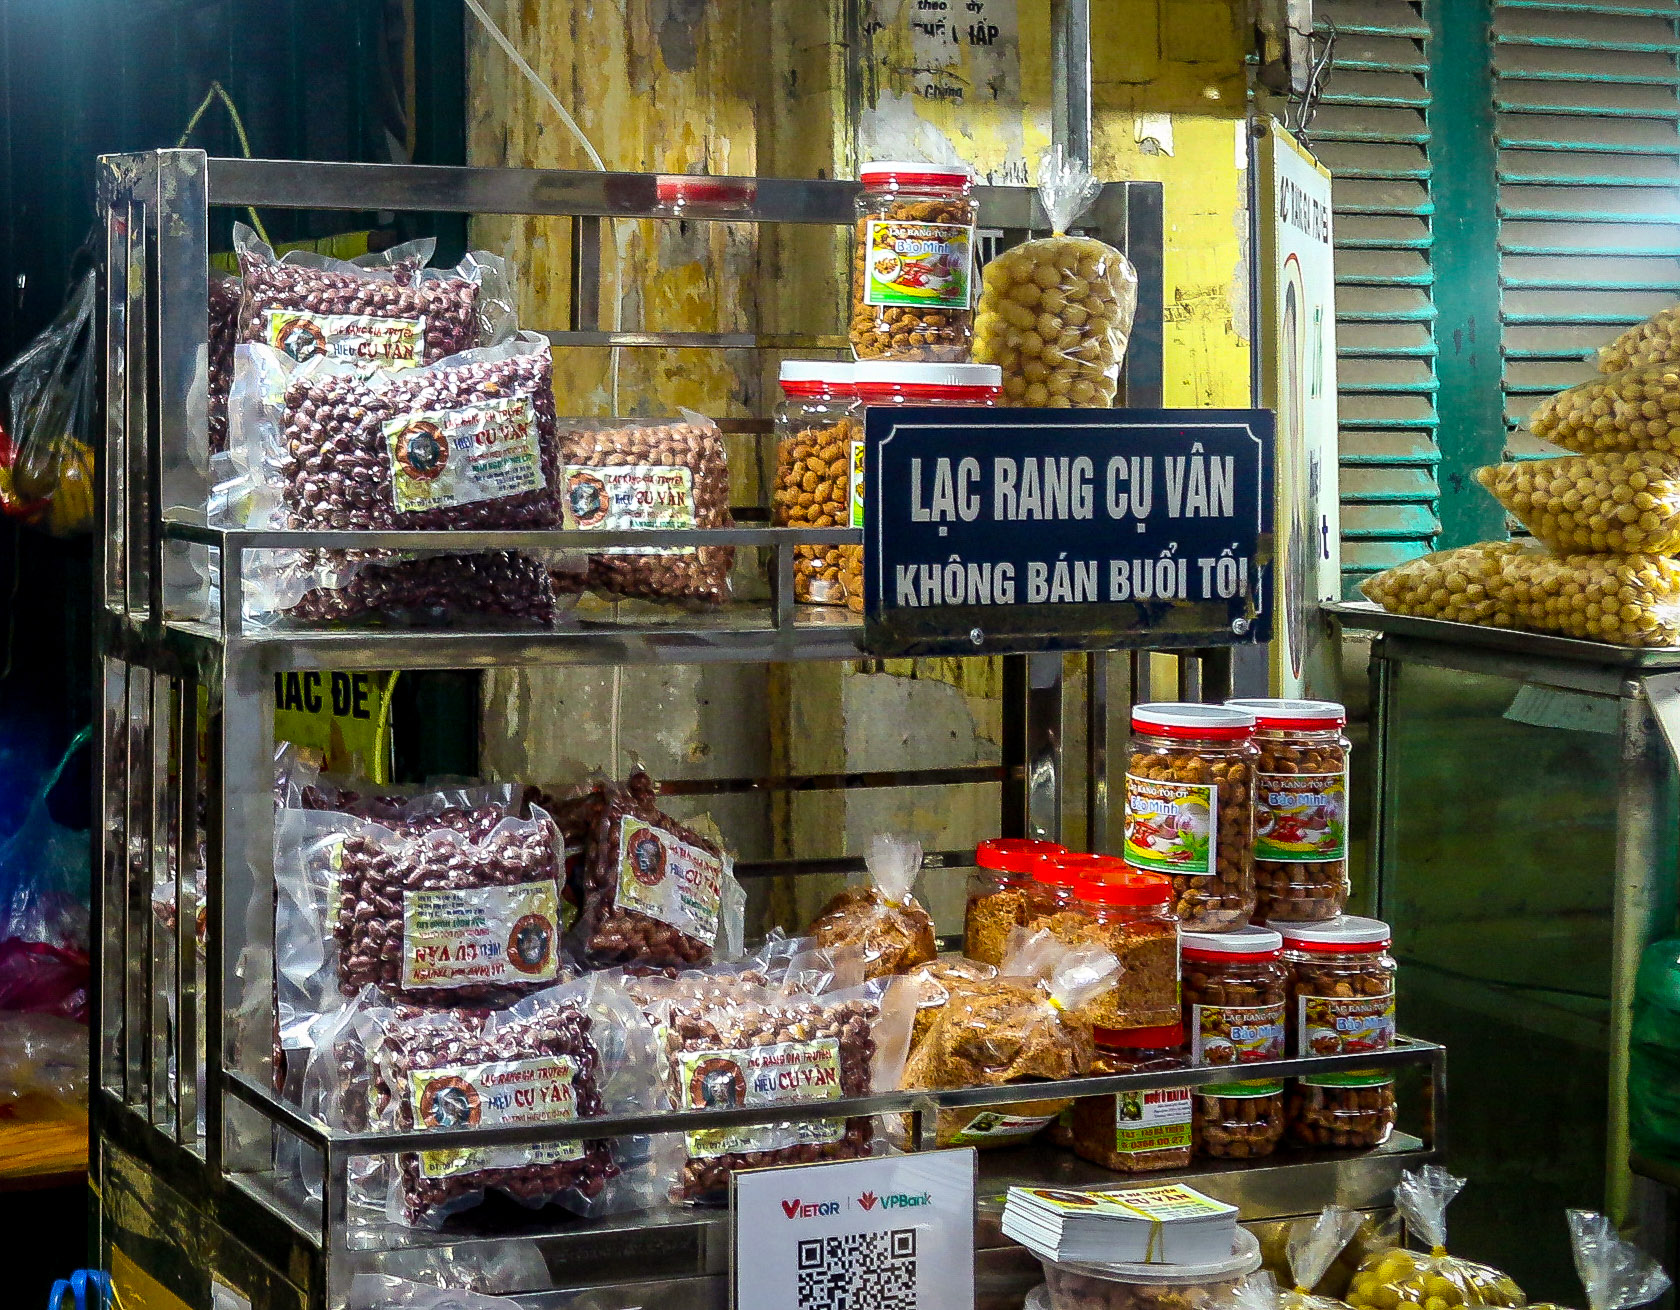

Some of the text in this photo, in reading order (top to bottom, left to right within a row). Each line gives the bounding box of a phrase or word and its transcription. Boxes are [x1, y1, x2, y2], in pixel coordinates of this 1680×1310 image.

[911, 456, 981, 536] LẠC
[994, 456, 1094, 521] RANG
[1106, 456, 1152, 533] CỤ
[1164, 442, 1234, 518] VÂN
[896, 542, 1249, 607] KHÔNG BÁN BUỔI TỐI
[1150, 800, 1179, 815] Minh
[515, 1088, 535, 1111] CỤ
[880, 1191, 932, 1210] VPBank
